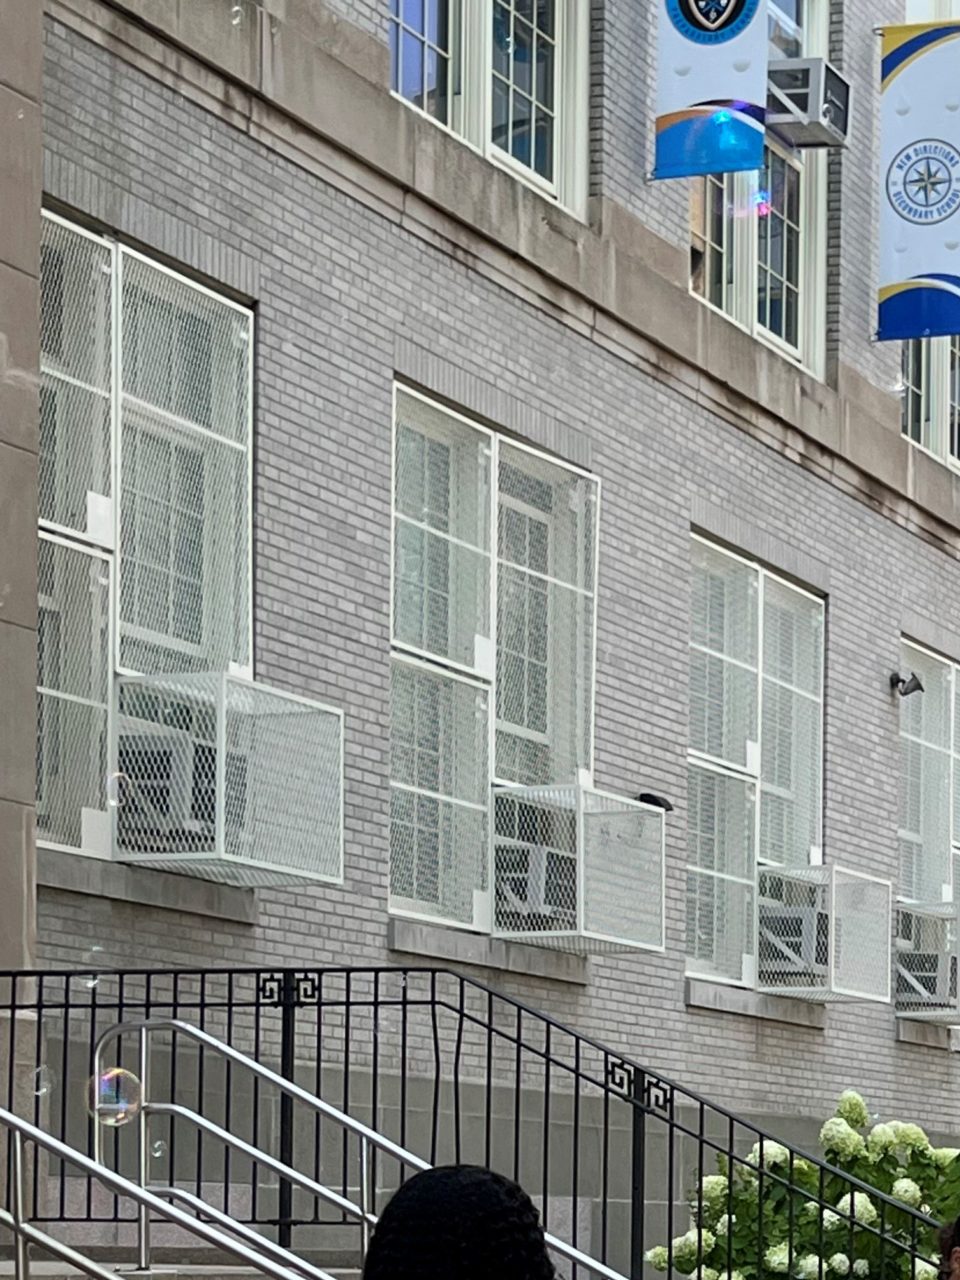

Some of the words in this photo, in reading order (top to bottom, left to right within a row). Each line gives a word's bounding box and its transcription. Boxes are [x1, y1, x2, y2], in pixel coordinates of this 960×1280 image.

[896, 152, 913, 171] NEW
[913, 144, 960, 168] DIRECTIONS
[893, 191, 934, 219] SECONDARY
